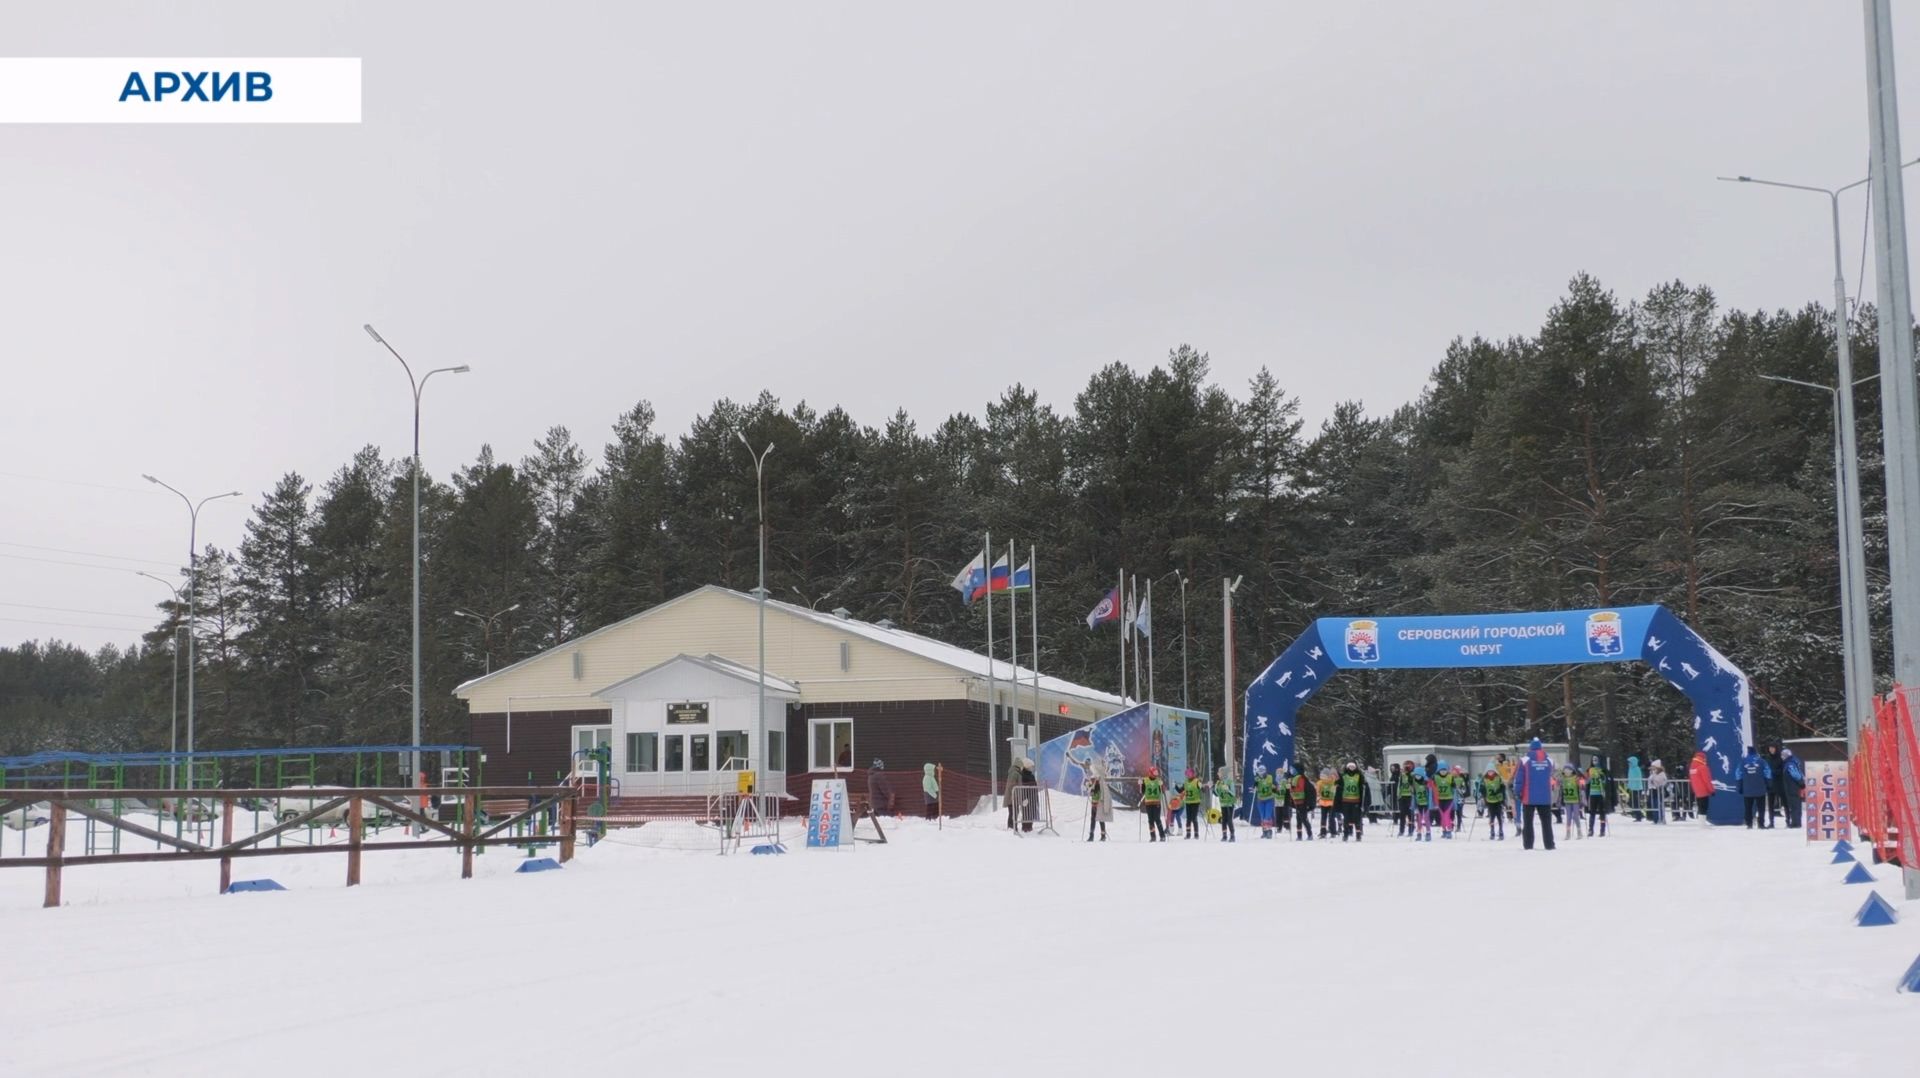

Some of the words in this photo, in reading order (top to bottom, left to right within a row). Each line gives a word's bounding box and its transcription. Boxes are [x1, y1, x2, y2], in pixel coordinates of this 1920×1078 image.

[1398, 626, 1480, 641] СЕРОВСКИЙ
[1484, 623, 1566, 639] ГОРОДСКОЙ
[1460, 644, 1502, 656] ОКРУГ
[1147, 786, 1158, 796] 34
[1346, 786, 1357, 794] 40
[1821, 774, 1835, 839] СТАРТ
[818, 790, 832, 846] СТАРТ
